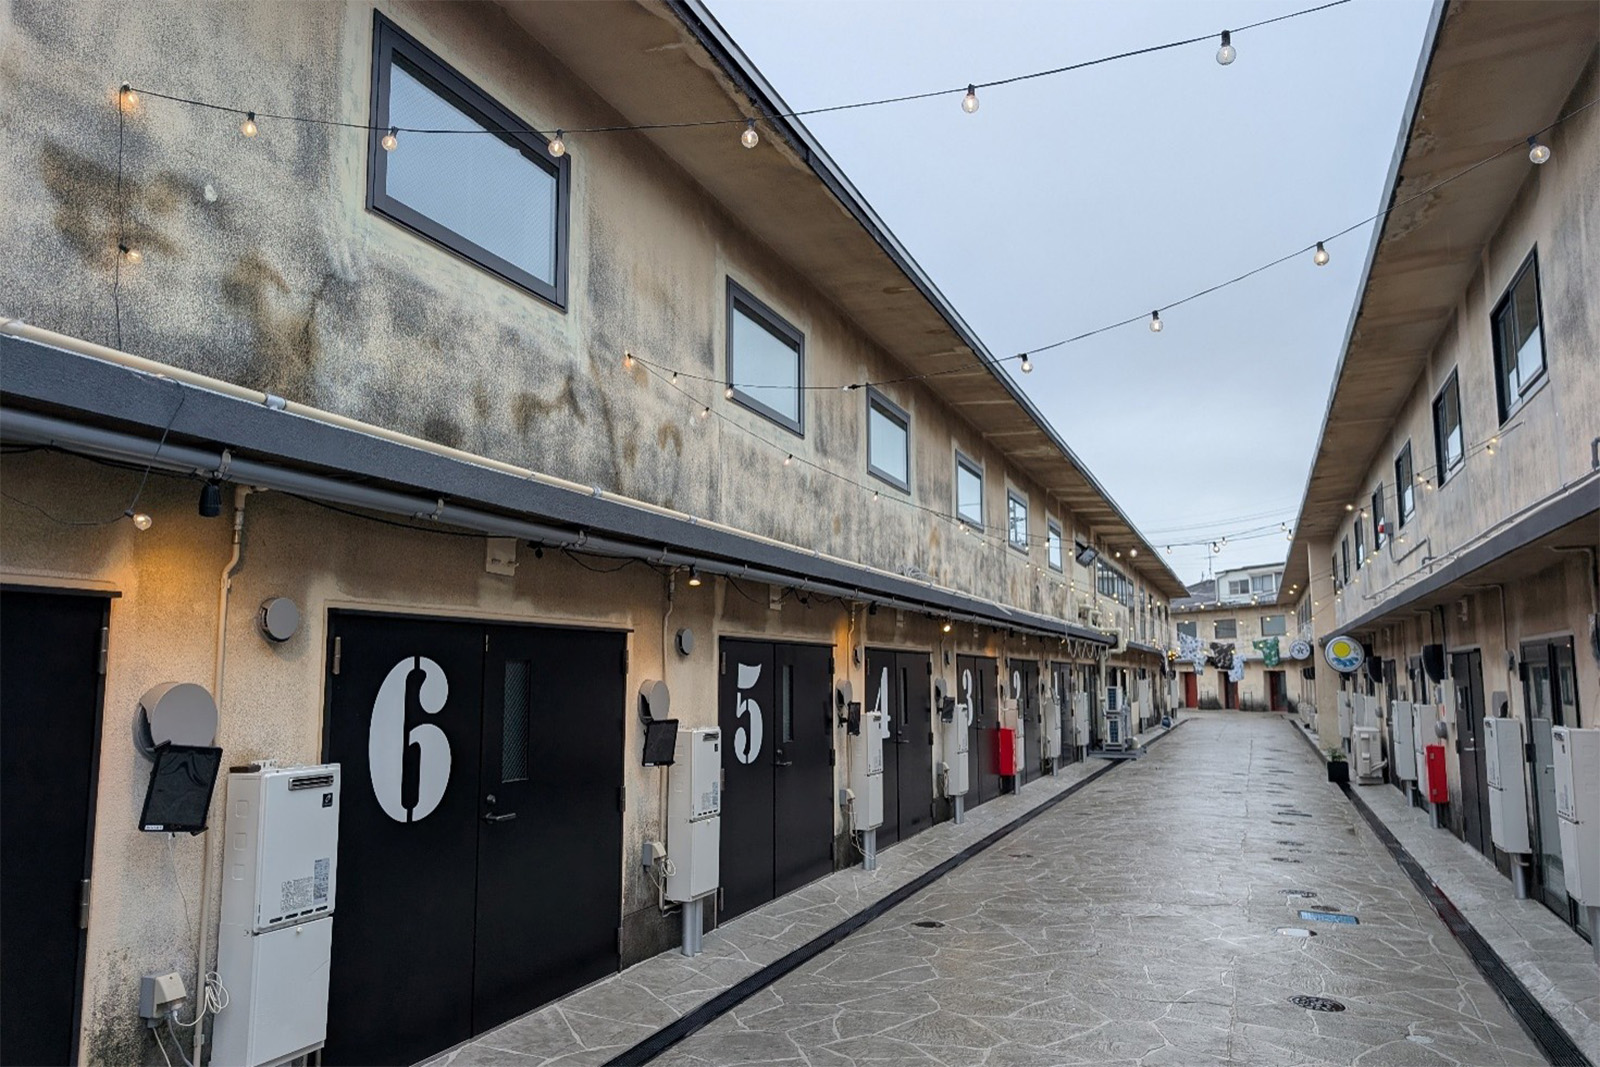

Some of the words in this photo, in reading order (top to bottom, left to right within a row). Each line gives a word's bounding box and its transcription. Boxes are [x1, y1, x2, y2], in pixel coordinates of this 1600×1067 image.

[368, 656, 452, 823] 6
[735, 663, 763, 764] 5
[874, 666, 891, 738] 4
[962, 668, 974, 727] 3
